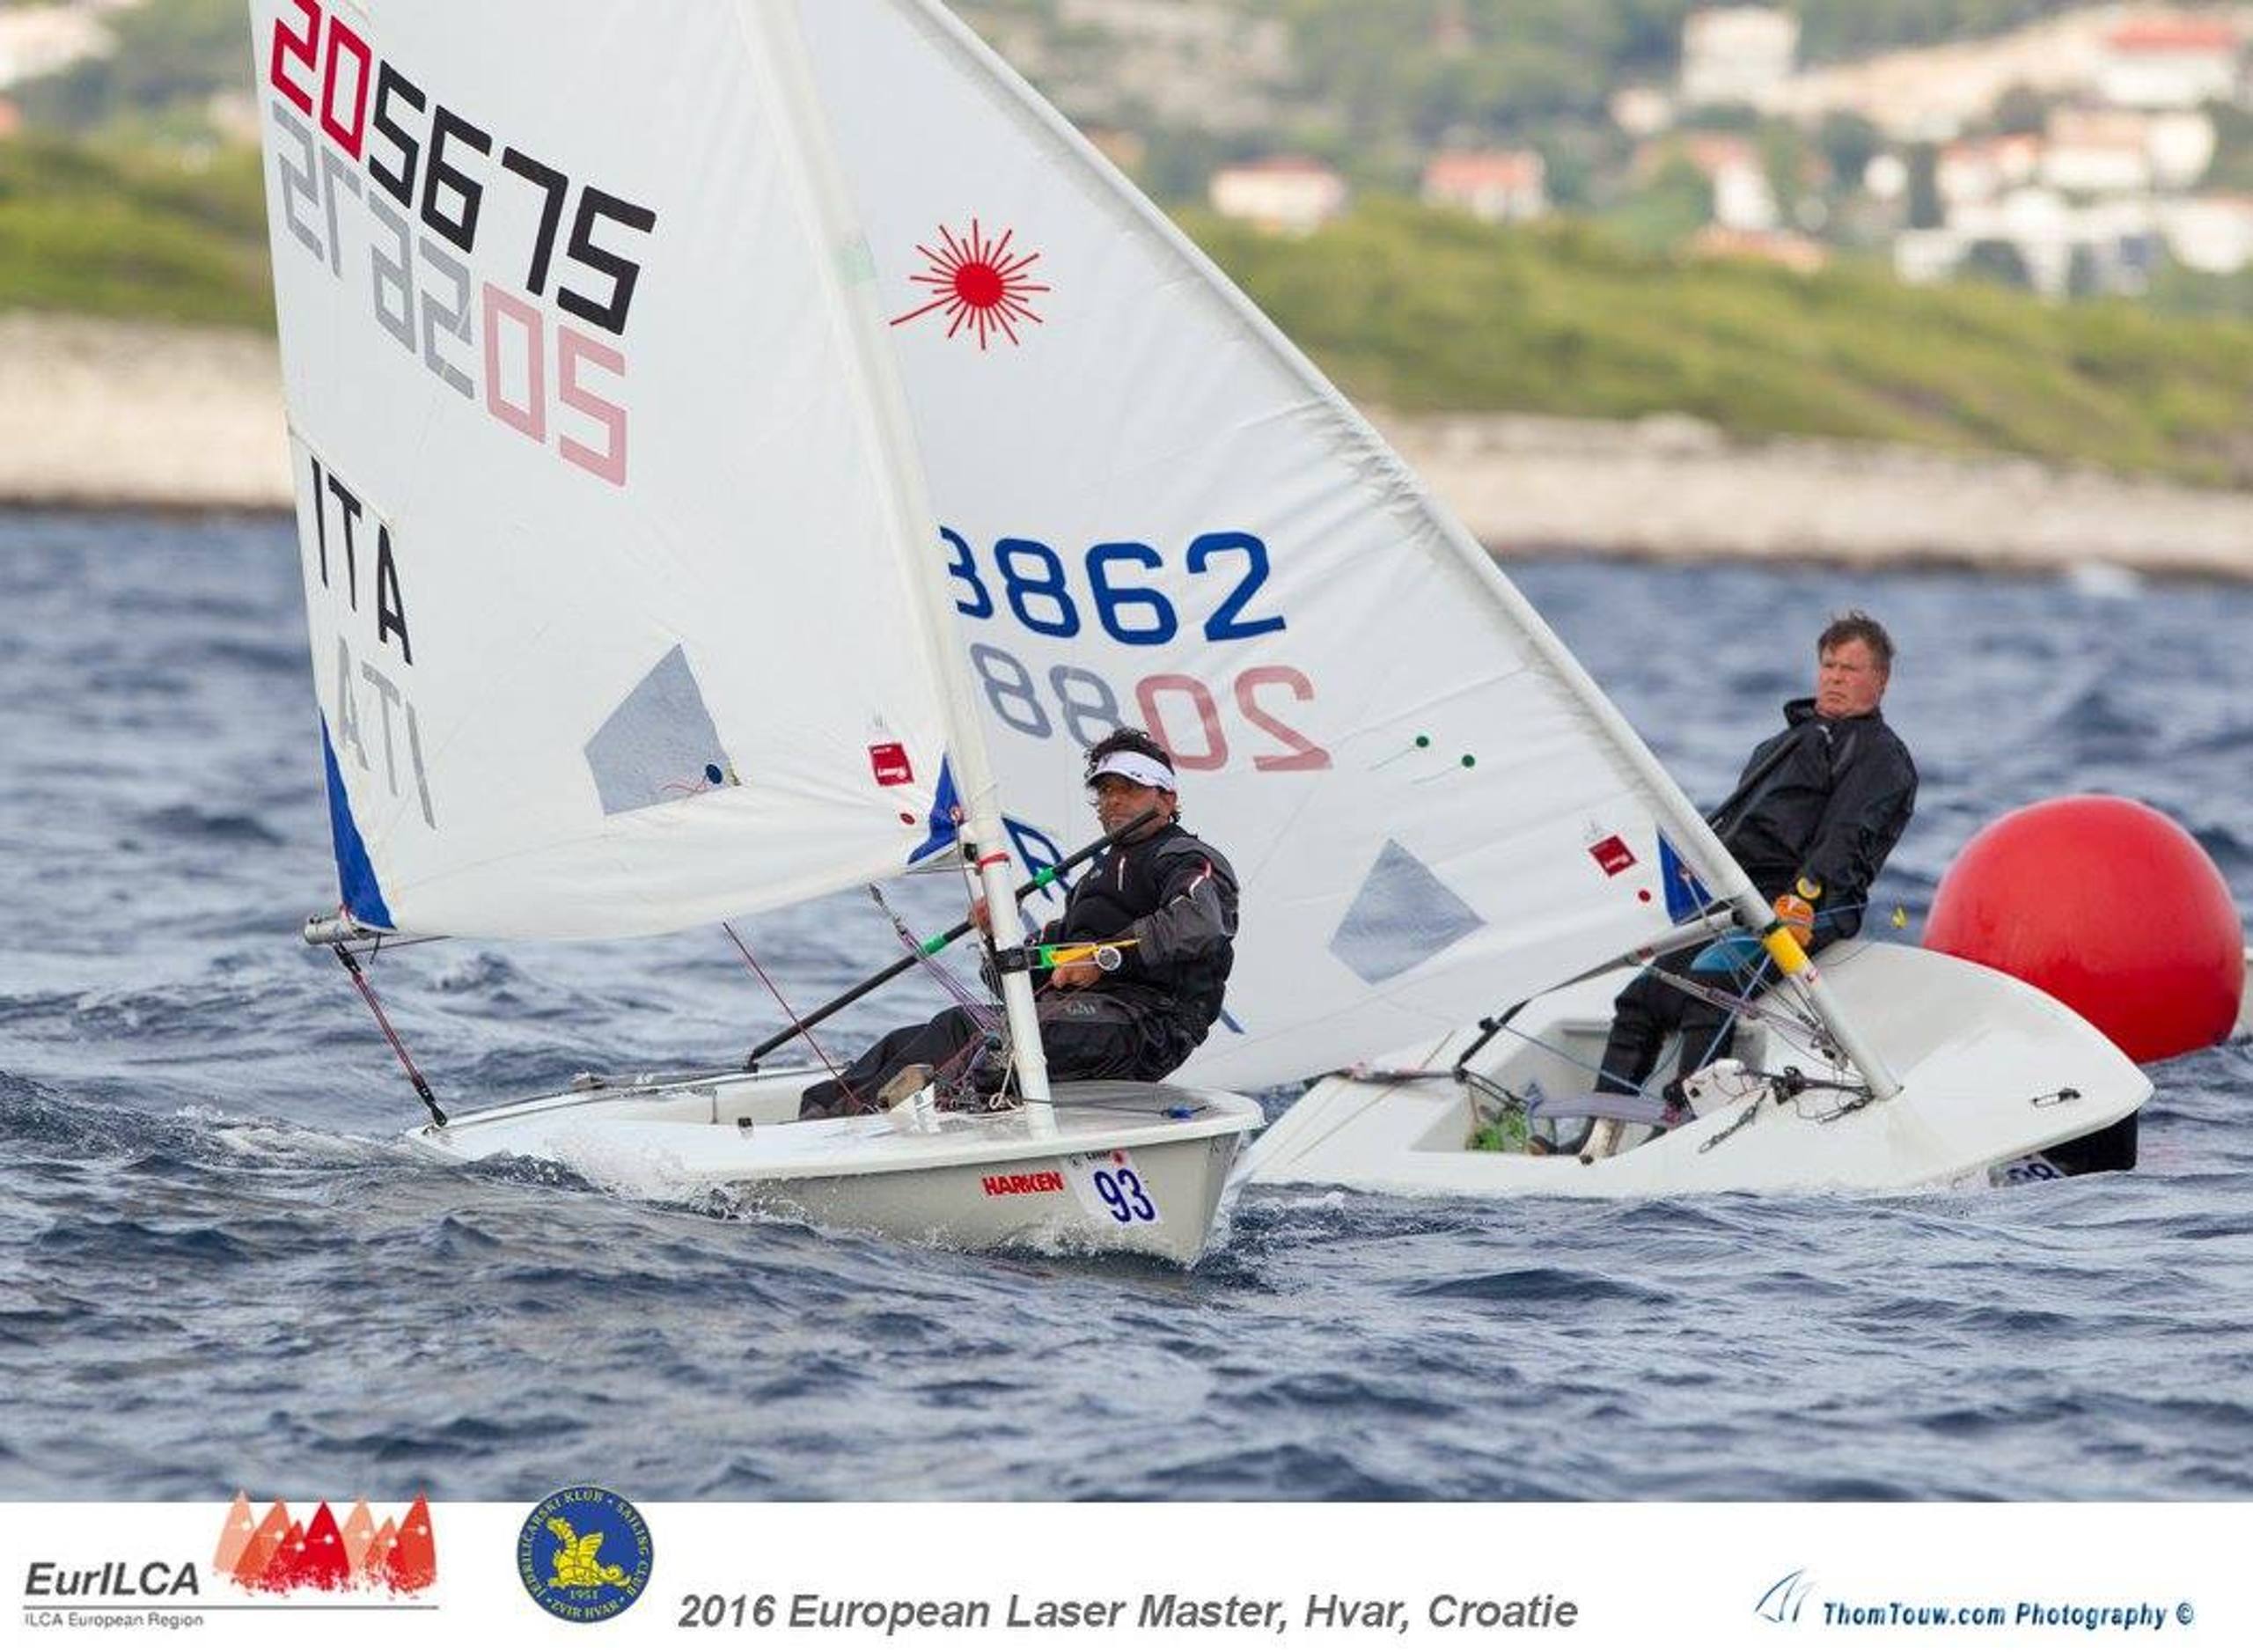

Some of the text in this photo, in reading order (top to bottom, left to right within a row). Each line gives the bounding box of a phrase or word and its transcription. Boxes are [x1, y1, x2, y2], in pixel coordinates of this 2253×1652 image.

[311, 455, 413, 666] ITA
[981, 1171, 1063, 1195] HARKEN
[1094, 1168, 1155, 1222] 93
